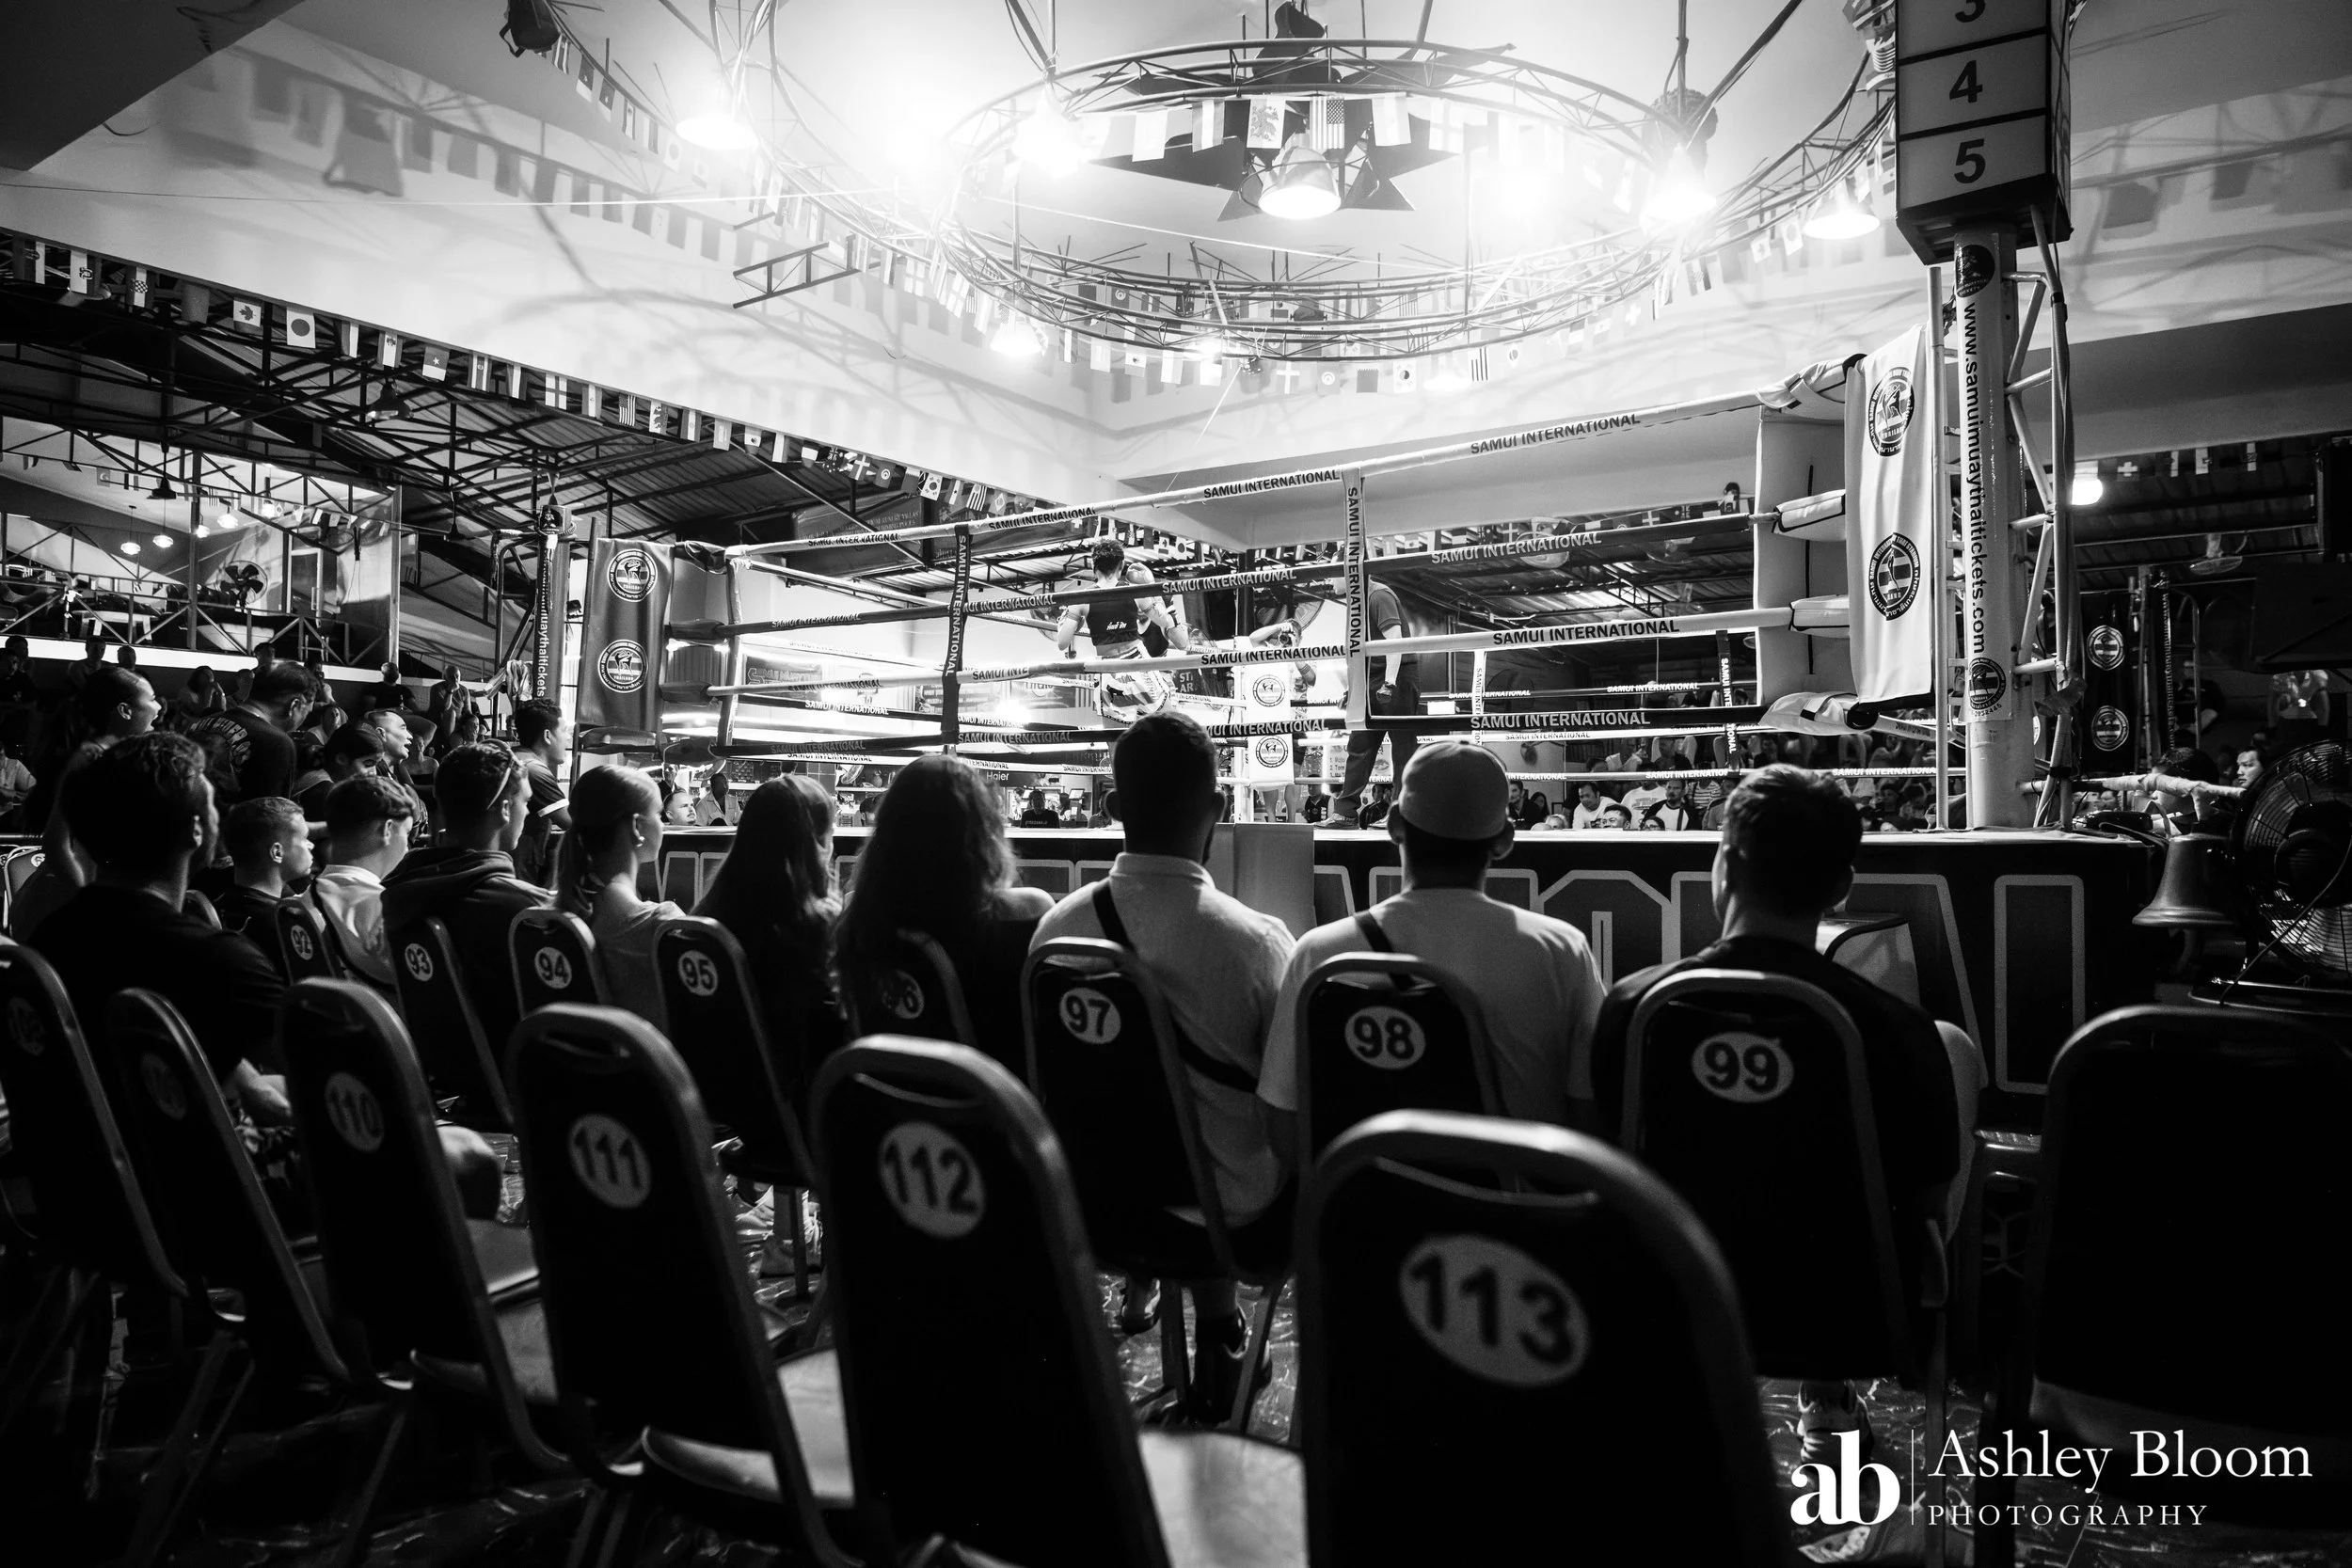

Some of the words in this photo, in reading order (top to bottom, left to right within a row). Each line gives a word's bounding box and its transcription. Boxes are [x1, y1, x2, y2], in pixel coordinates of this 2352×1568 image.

[1949, 60, 1983, 103] 4
[1954, 138, 1986, 184] 5
[1470, 436, 1518, 454] SAMUI
[1521, 414, 1641, 445] INTERNATIONAL
[1203, 484, 1242, 499] SAMUI
[1245, 469, 1340, 492] INTERNATIONAL
[1963, 302, 1988, 654] www.samuimuaythaitickets.com
[989, 518, 1021, 530] SAMUI
[1022, 507, 1096, 526] INTERNATIONAL
[1348, 487, 1360, 537] SAMUI
[958, 535, 966, 577] SAMUI
[1431, 547, 1479, 564] SAMUI
[1483, 533, 1602, 558] INTERNATIONAL
[1162, 579, 1201, 594] SAMUI
[1203, 569, 1297, 590] INTERNATIONAL
[1347, 541, 1360, 657] INTERNATIONAL
[964, 602, 979, 612] MUI
[981, 595, 1057, 611] INTERNATIONAL
[945, 580, 965, 676] INTERNATIONAL
[1493, 629, 1545, 645] SAMUI
[1549, 620, 1680, 641] INTERNATIONAL
[1200, 652, 1243, 665] SAMUI
[1245, 644, 1346, 661] INTERNATIONAL
[973, 670, 1005, 680] SAMUI
[958, 732, 992, 743] SAMUI
[993, 731, 1073, 743] INTERNATIONAL
[1206, 725, 1226, 736] MUI
[1230, 719, 1329, 736] INTERNATIONAL
[1470, 716, 1520, 729] SAMUI
[1525, 711, 1651, 727] INTERNATIONAL
[1723, 688, 1738, 753] INTETIONAL
[771, 742, 800, 753] SAMUI
[801, 740, 866, 752] INTERNATIONAL
[986, 772, 1009, 782] Haier
[1865, 767, 1937, 775] INTERNATIONA
[405, 945, 432, 976] 93
[537, 948, 571, 985] 94
[679, 955, 713, 992] 95
[1063, 994, 1112, 1037] 97
[1354, 1014, 1414, 1061] 98
[1703, 1041, 1780, 1096] 99
[327, 1081, 385, 1139] 110
[572, 1127, 644, 1192] 111
[882, 1140, 981, 1214] 112
[1406, 1252, 1575, 1367] 113
